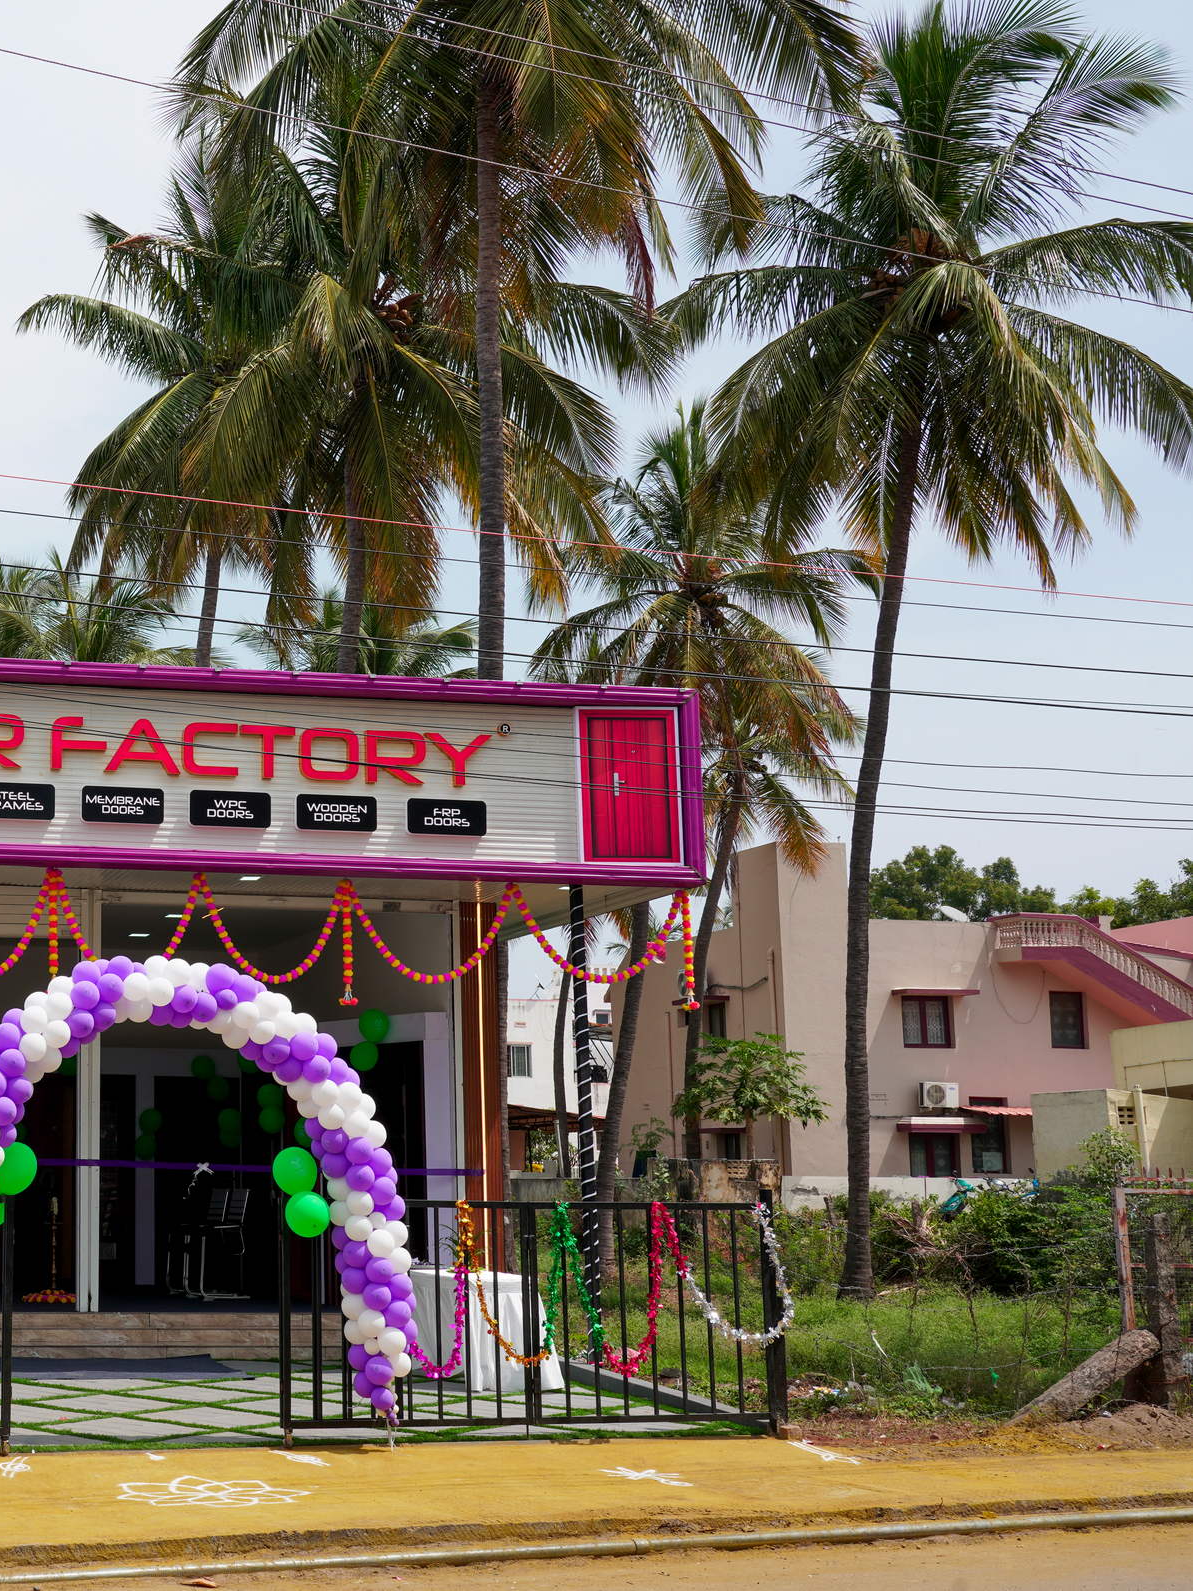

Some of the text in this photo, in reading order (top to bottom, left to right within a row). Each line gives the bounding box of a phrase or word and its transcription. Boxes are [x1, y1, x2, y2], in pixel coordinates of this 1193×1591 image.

[50, 715, 492, 788] FACTORY
[85, 795, 161, 807] MEMBRANE
[214, 799, 247, 810] WPC
[101, 805, 144, 816] DOORS
[207, 808, 254, 820] DOORS
[306, 803, 368, 814] WOODEN
[432, 807, 460, 818] FRP
[314, 812, 361, 823] DOORS
[424, 816, 470, 828] DOORS
